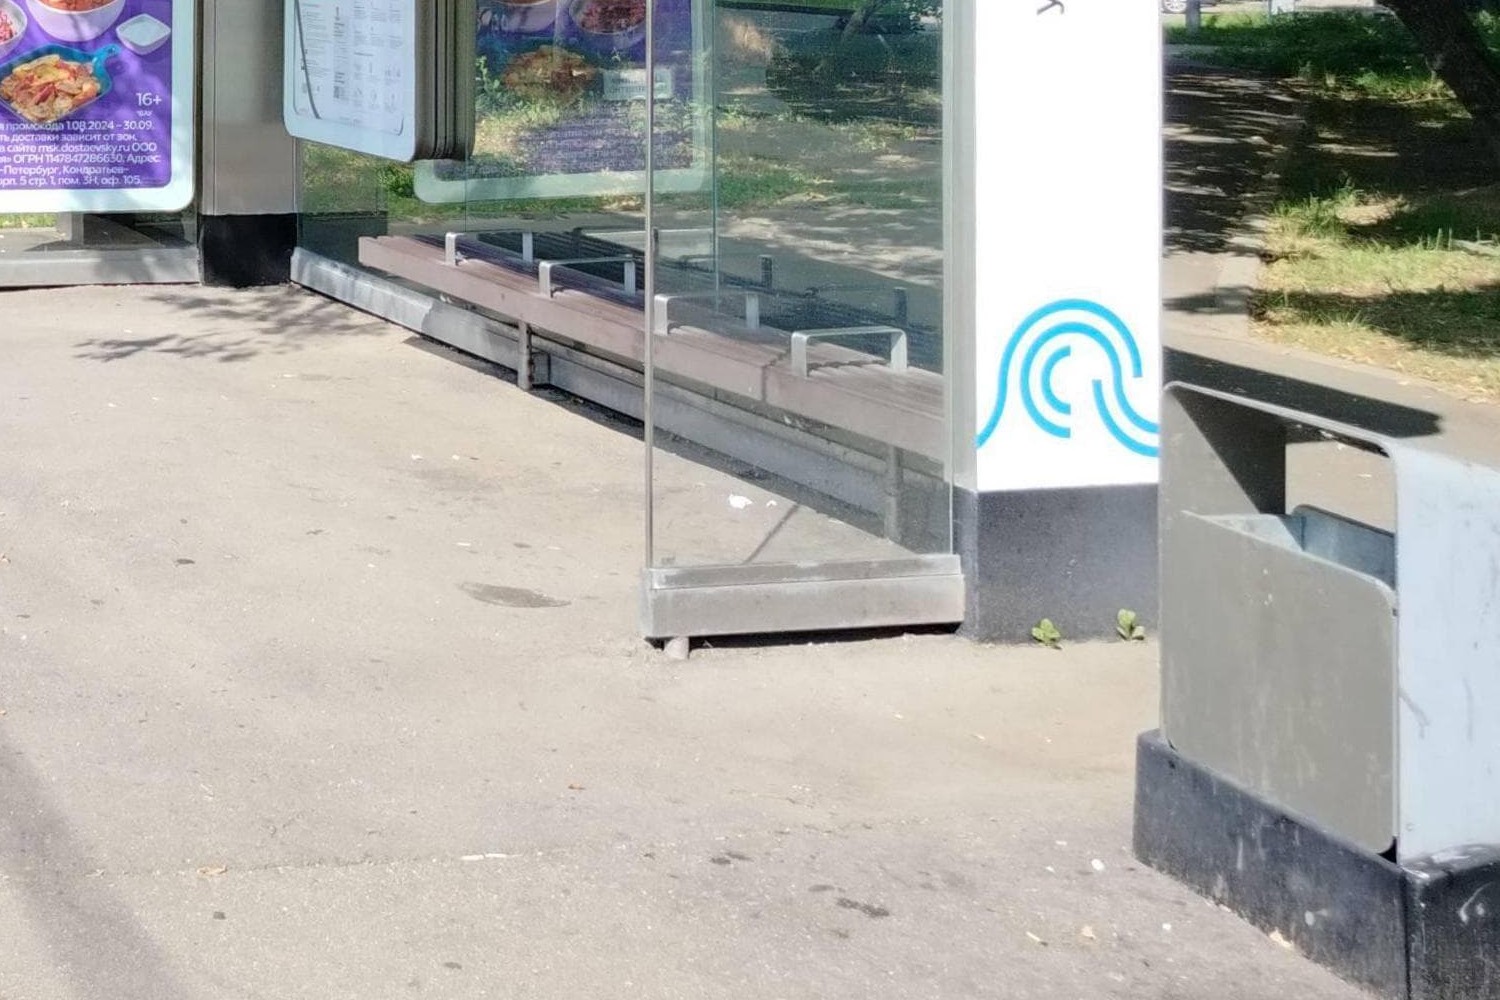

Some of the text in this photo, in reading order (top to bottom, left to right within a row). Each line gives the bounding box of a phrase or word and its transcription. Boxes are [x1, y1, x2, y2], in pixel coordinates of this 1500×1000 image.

[136, 93, 162, 106] 16+
[6, 122, 64, 132] промокода
[11, 133, 59, 143] доставки
[60, 133, 100, 141] зависит
[7, 143, 36, 153] сайте
[131, 142, 157, 152] ООО
[13, 155, 43, 164] ОГРН
